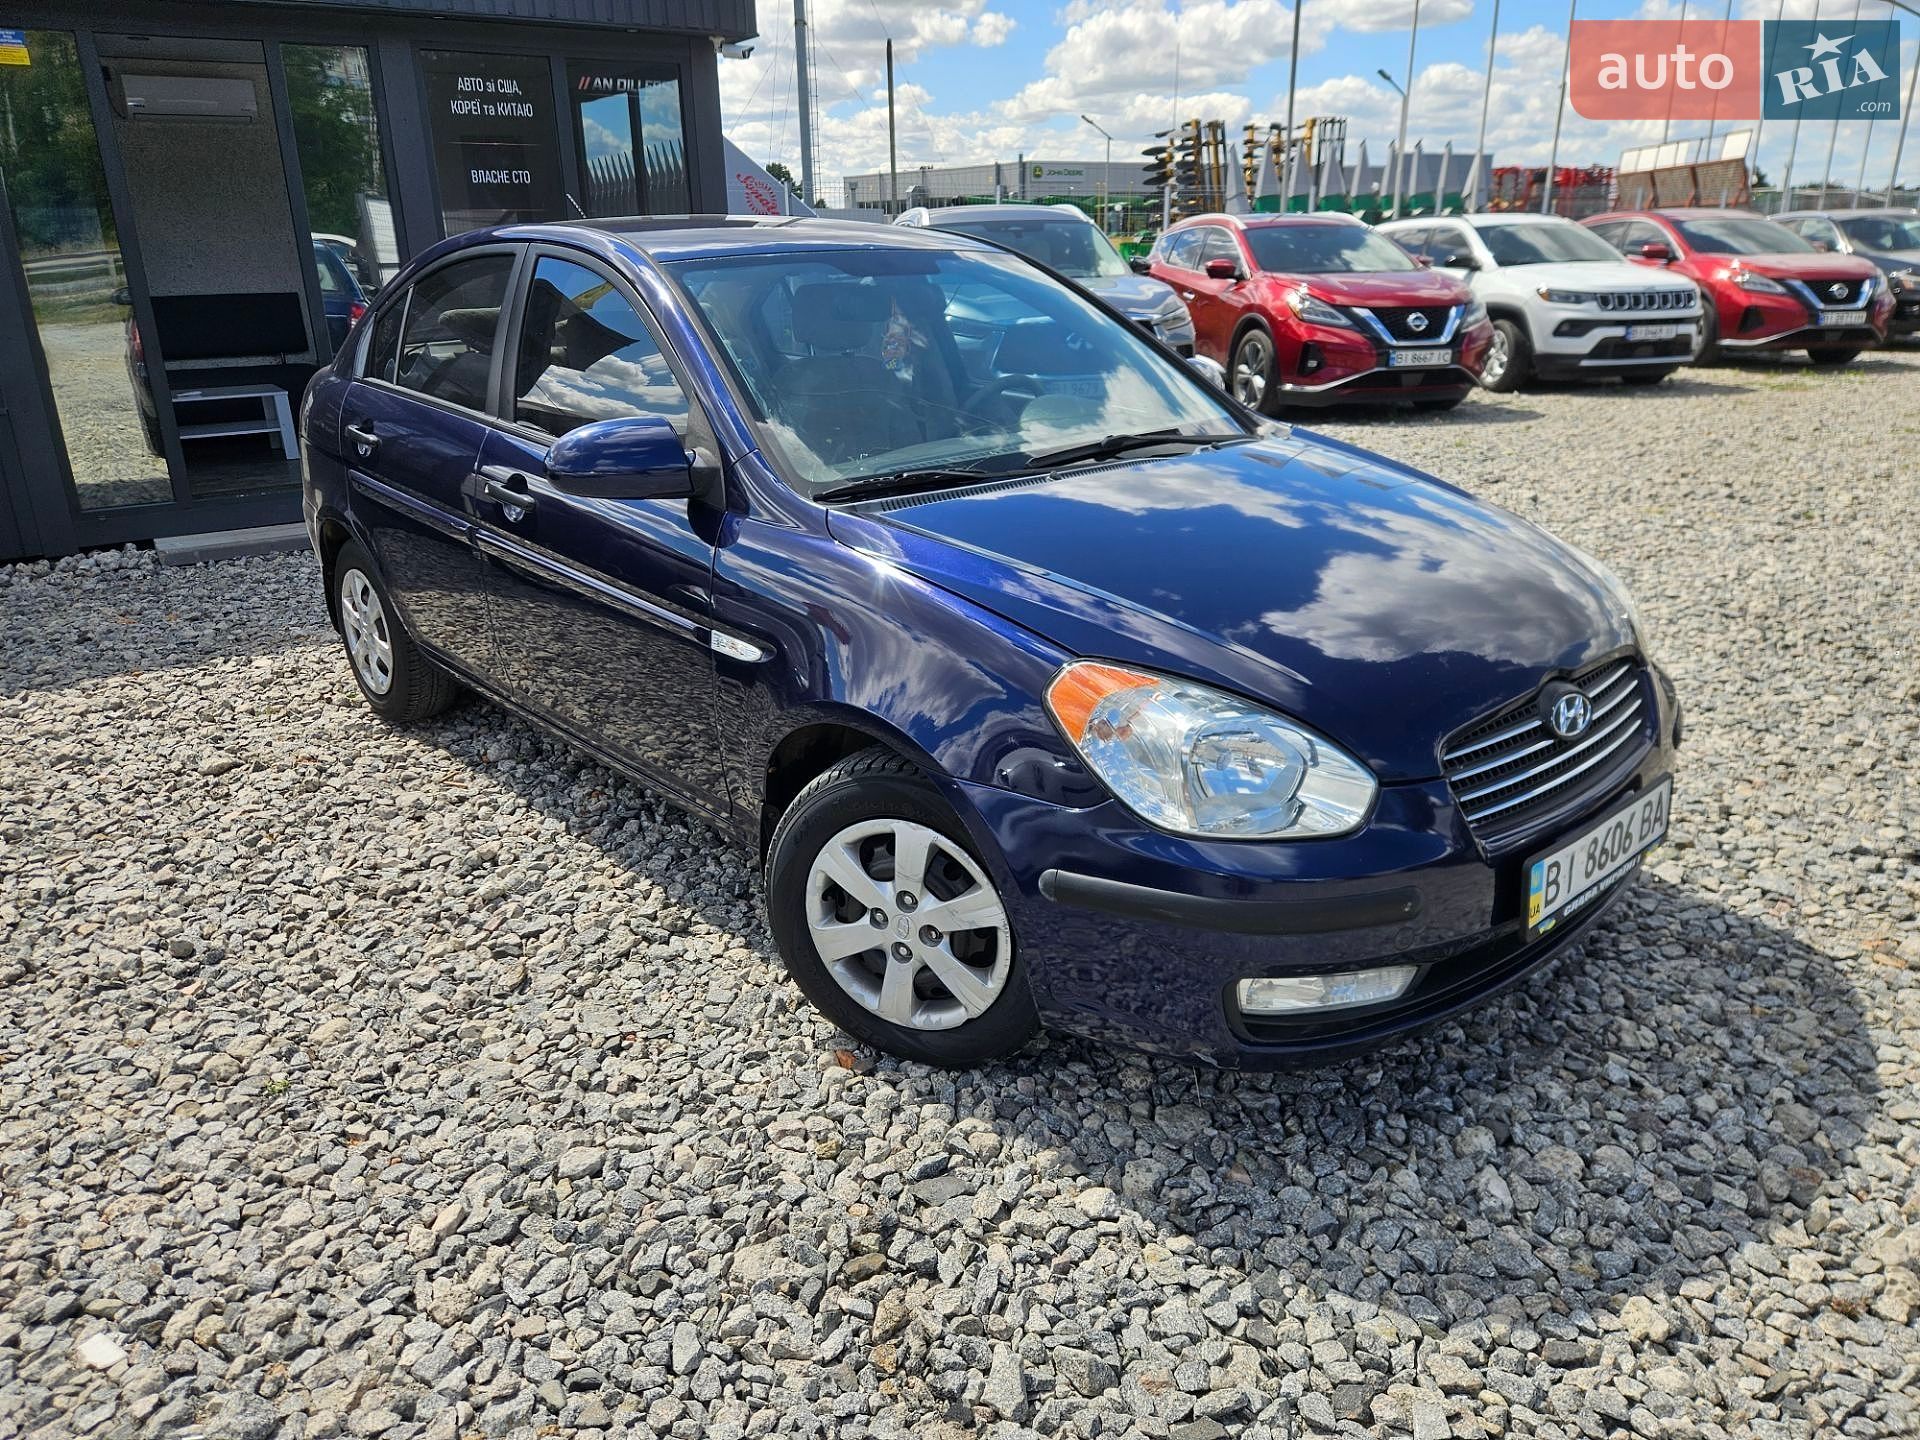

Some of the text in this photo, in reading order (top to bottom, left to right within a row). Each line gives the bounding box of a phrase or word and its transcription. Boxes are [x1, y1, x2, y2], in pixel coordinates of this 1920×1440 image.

[457, 77, 522, 95] АВТО зі США,
[450, 99, 534, 118] КОРЕЇ та КИТАЮ
[471, 169, 531, 184] ВЛАСНЕ СТО
[1544, 791, 1663, 909] BI 8606 BA
